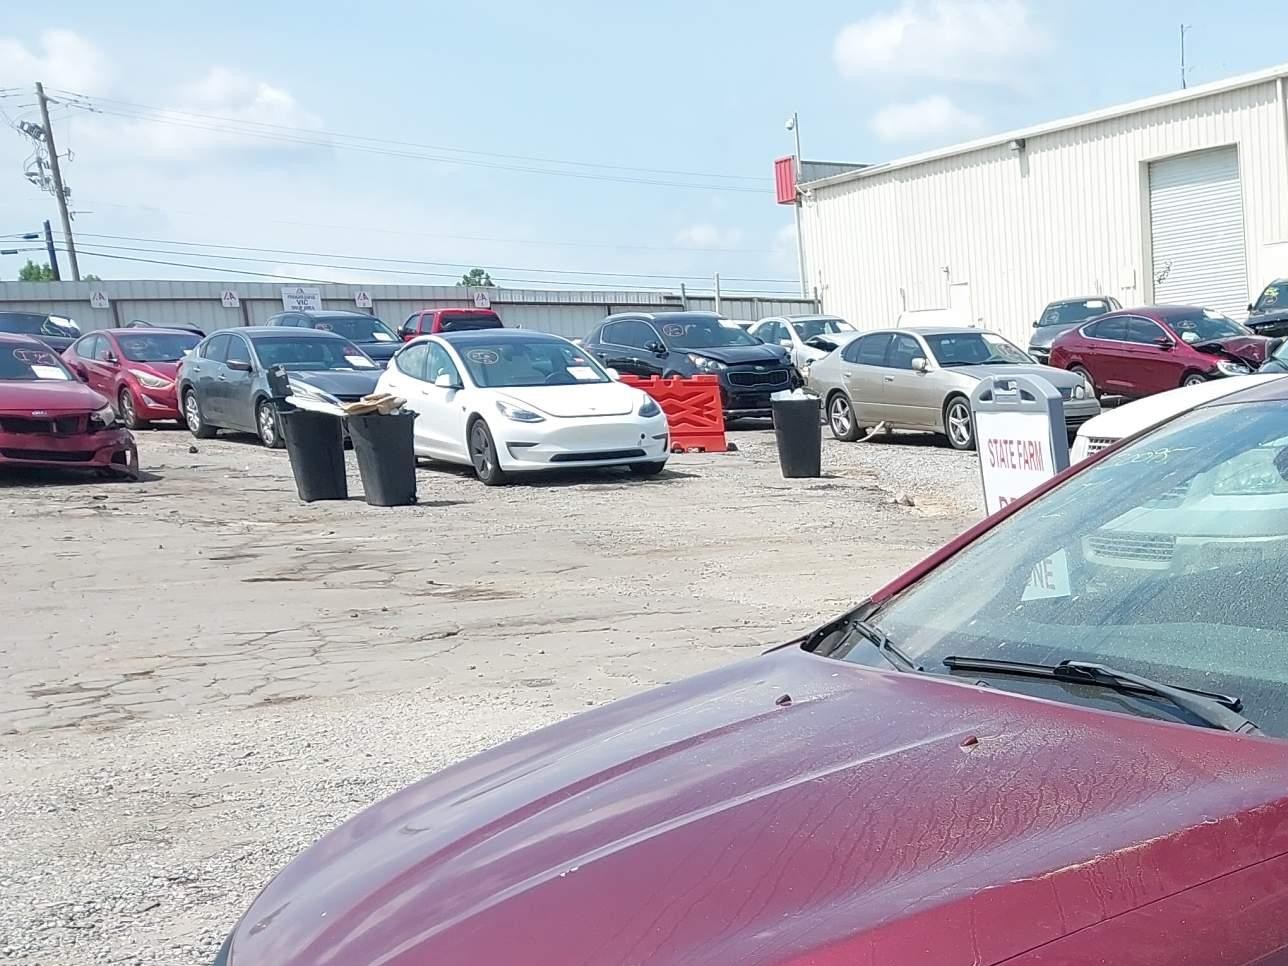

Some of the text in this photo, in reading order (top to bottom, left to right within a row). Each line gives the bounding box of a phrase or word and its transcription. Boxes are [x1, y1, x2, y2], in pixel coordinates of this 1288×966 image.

[987, 438, 1045, 471] STATE FARM
[1025, 559, 1055, 590] NE
